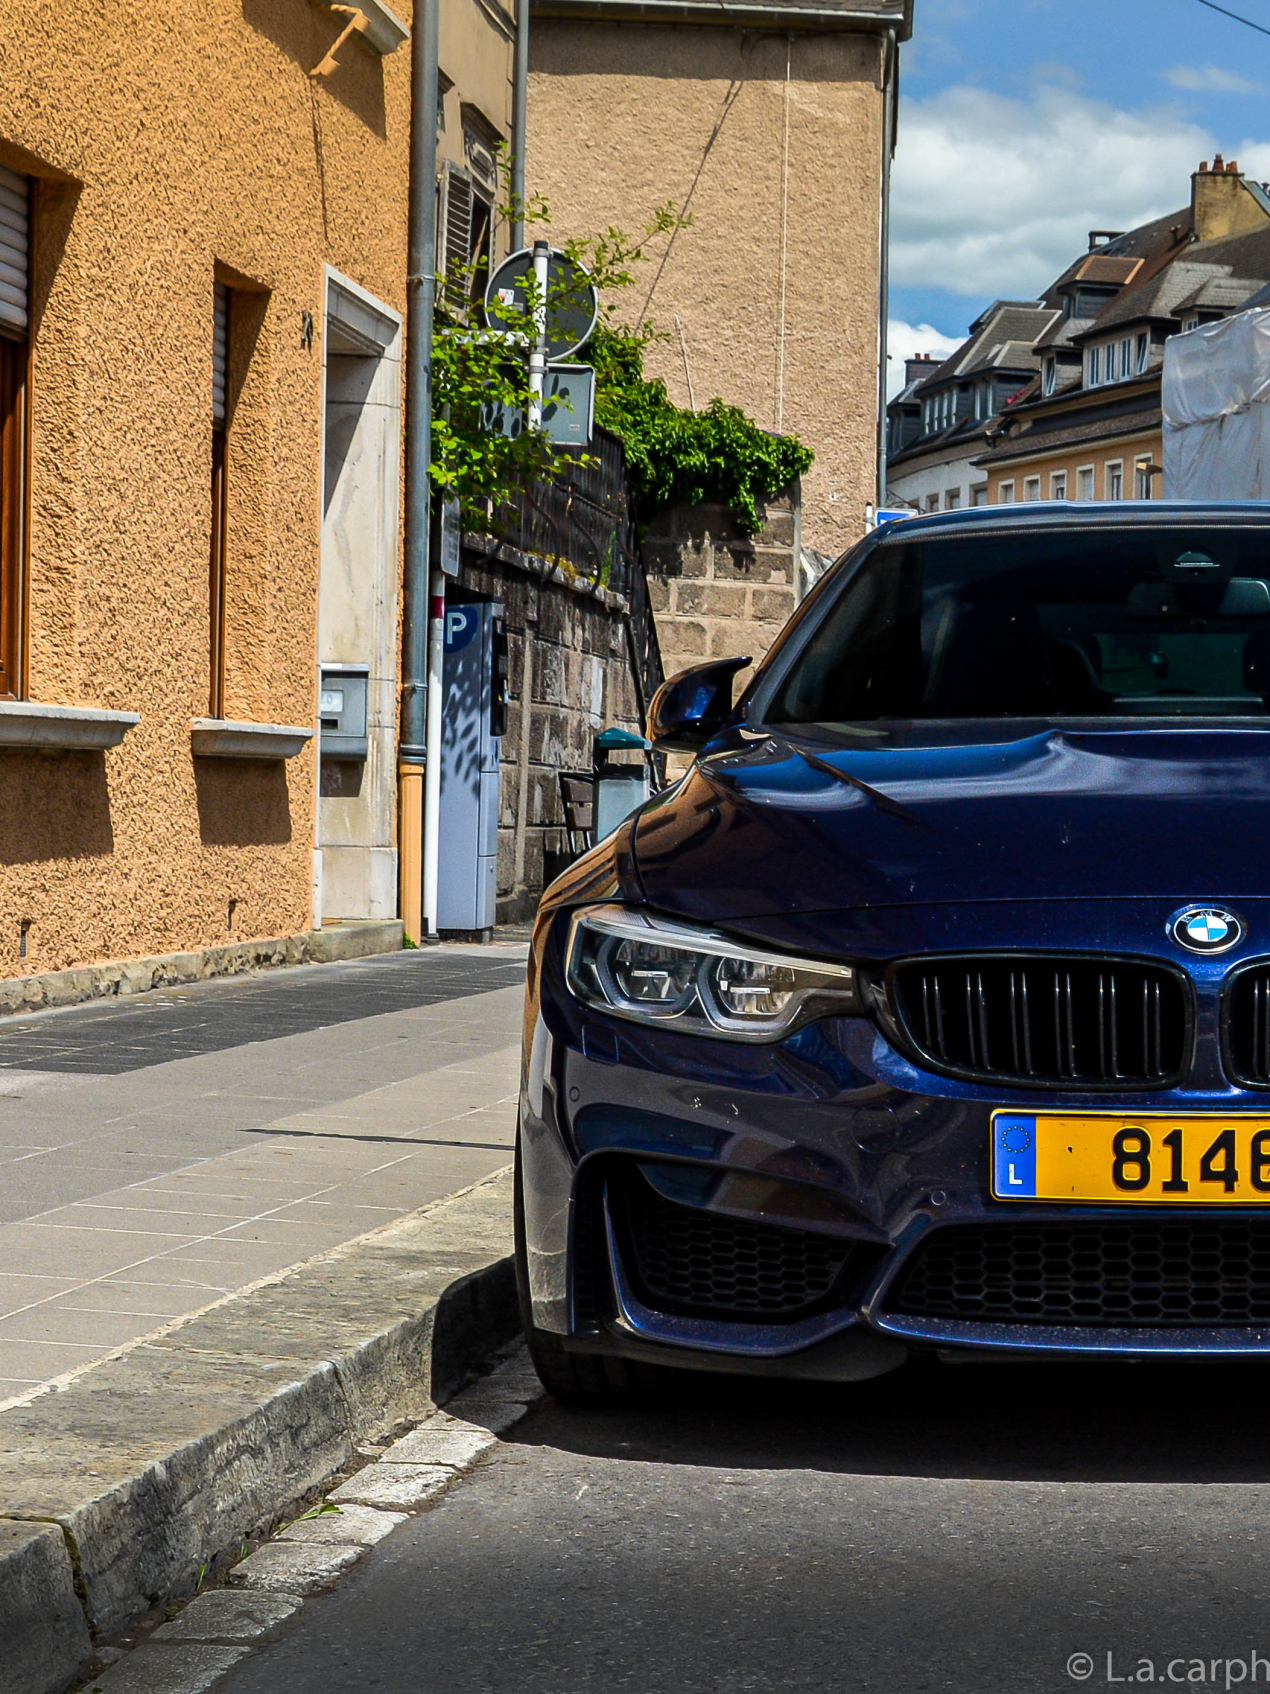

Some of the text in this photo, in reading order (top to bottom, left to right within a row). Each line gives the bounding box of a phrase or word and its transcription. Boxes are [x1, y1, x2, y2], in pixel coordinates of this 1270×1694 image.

[446, 612, 467, 644] P
[1180, 909, 1234, 923] BMW
[1009, 1164, 1022, 1185] L
